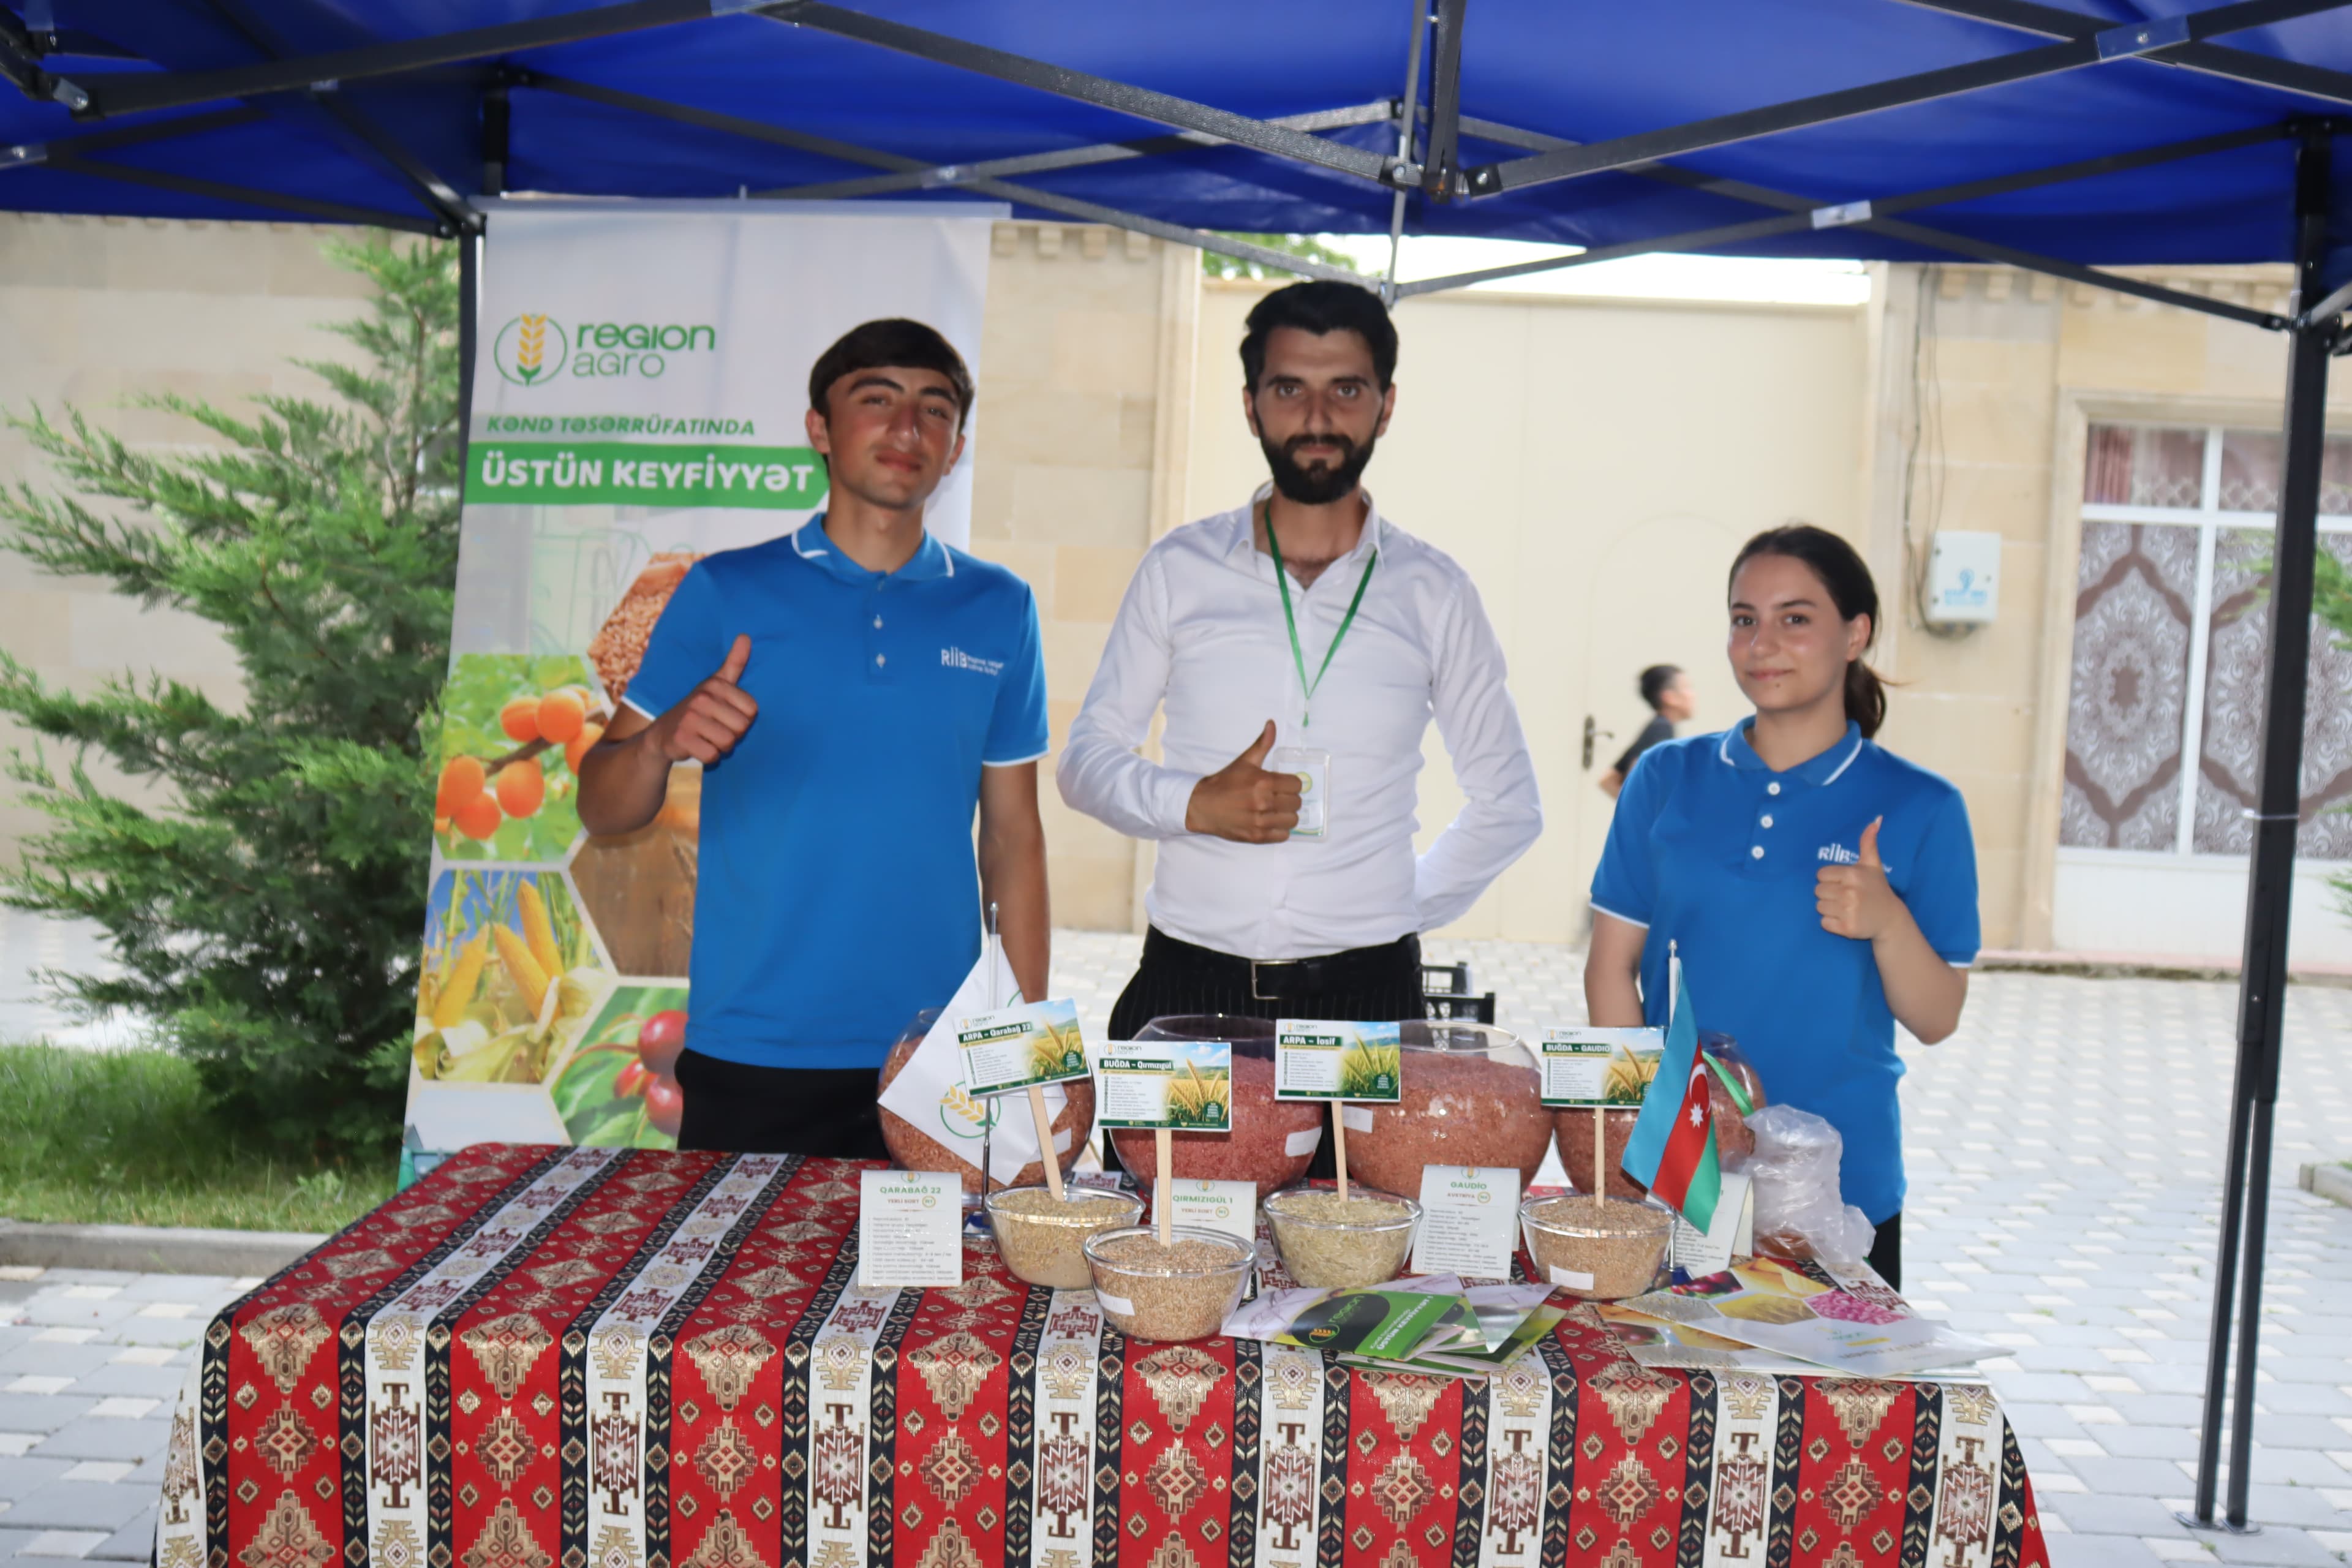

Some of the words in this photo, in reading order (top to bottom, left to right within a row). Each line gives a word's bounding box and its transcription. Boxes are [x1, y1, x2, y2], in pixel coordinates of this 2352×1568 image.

[486, 415, 554, 433] KƏND
[560, 413, 755, 436] TƏSƏRRÜFATINDA
[481, 451, 602, 487] ÜSTÜN
[612, 453, 815, 492] KEYFİYYƏT
[963, 1031, 983, 1042] ARPA
[990, 1025, 1021, 1036] Qarabağ
[1283, 1036, 1306, 1044] ARPA
[1545, 1043, 1573, 1052] BUĞDA
[1104, 1058, 1131, 1068] BUĞDA
[880, 1185, 928, 1194] QARABAĞ
[1172, 1194, 1227, 1204] QIRMIZIGÜL
